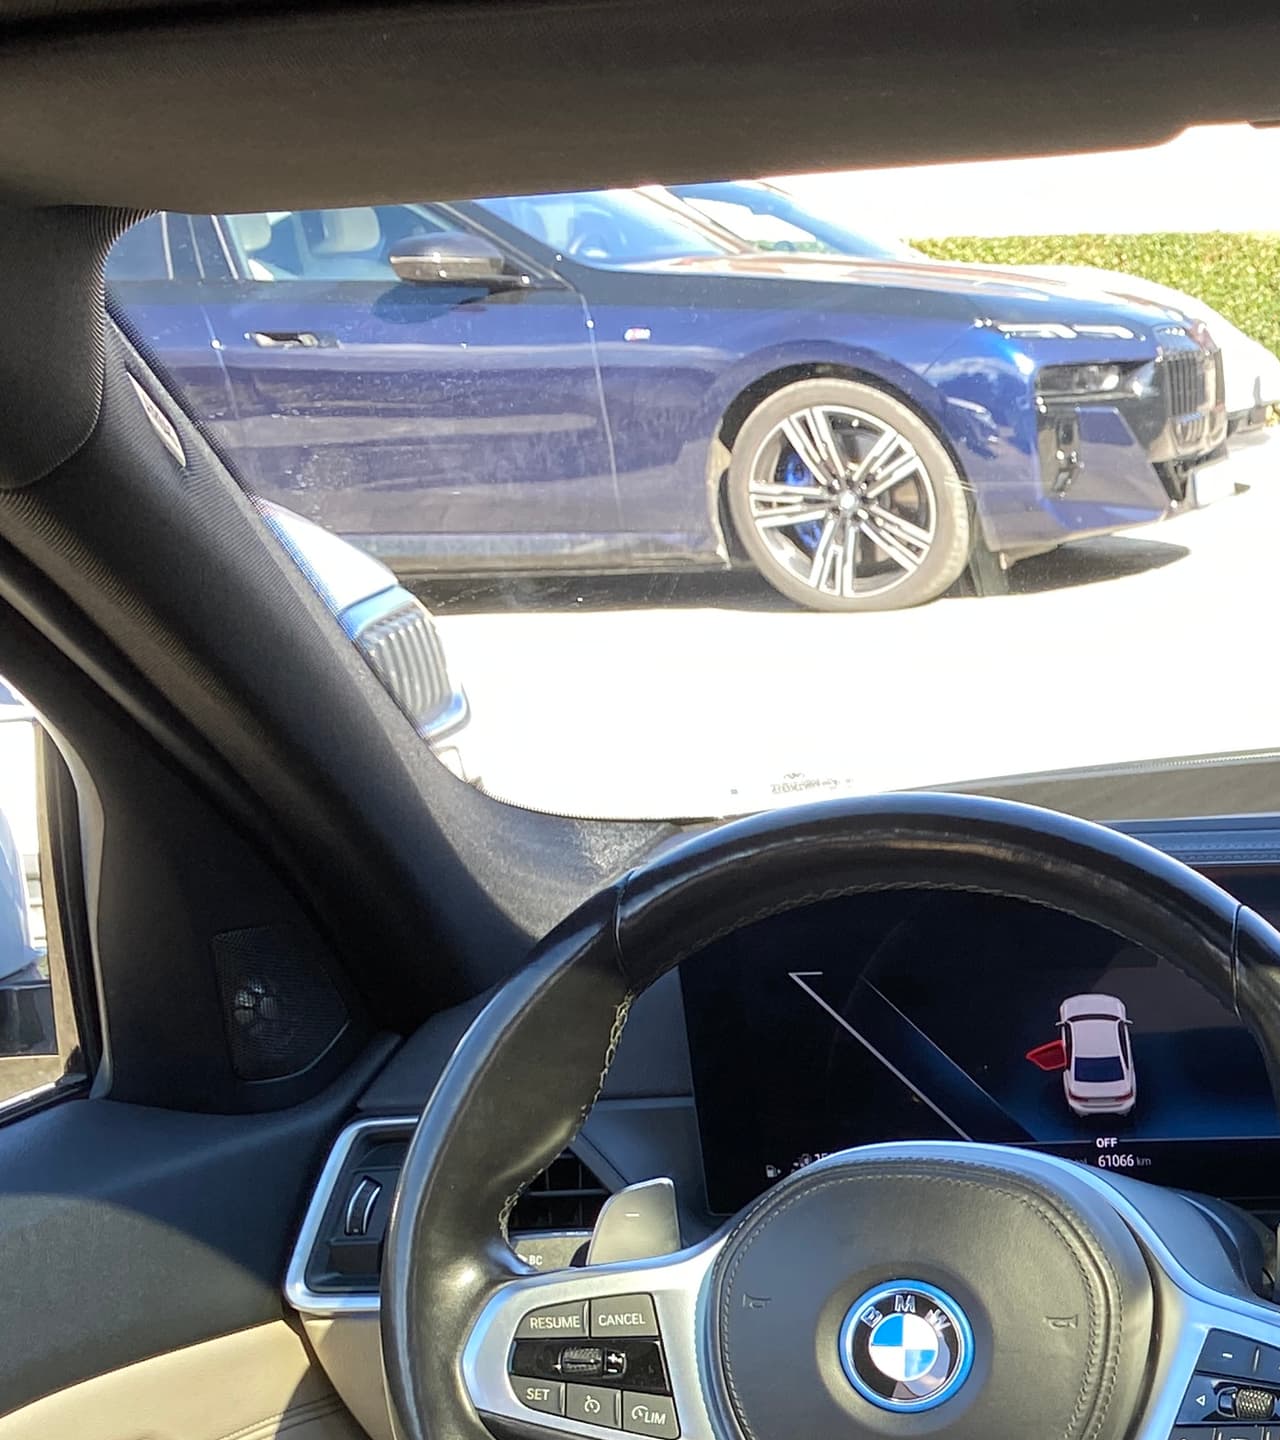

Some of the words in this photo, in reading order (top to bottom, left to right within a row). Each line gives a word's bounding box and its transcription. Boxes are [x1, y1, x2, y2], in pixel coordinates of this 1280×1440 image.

[1096, 1137, 1118, 1148] OFF
[1098, 1153, 1134, 1167] 61066
[1136, 1156, 1152, 1166] km
[528, 1254, 543, 1266] BC
[860, 1294, 951, 1328] BMW
[529, 1315, 581, 1330] RESUME
[598, 1311, 646, 1327] CANCEL
[526, 1387, 550, 1401] SET
[644, 1410, 667, 1426] LIM
